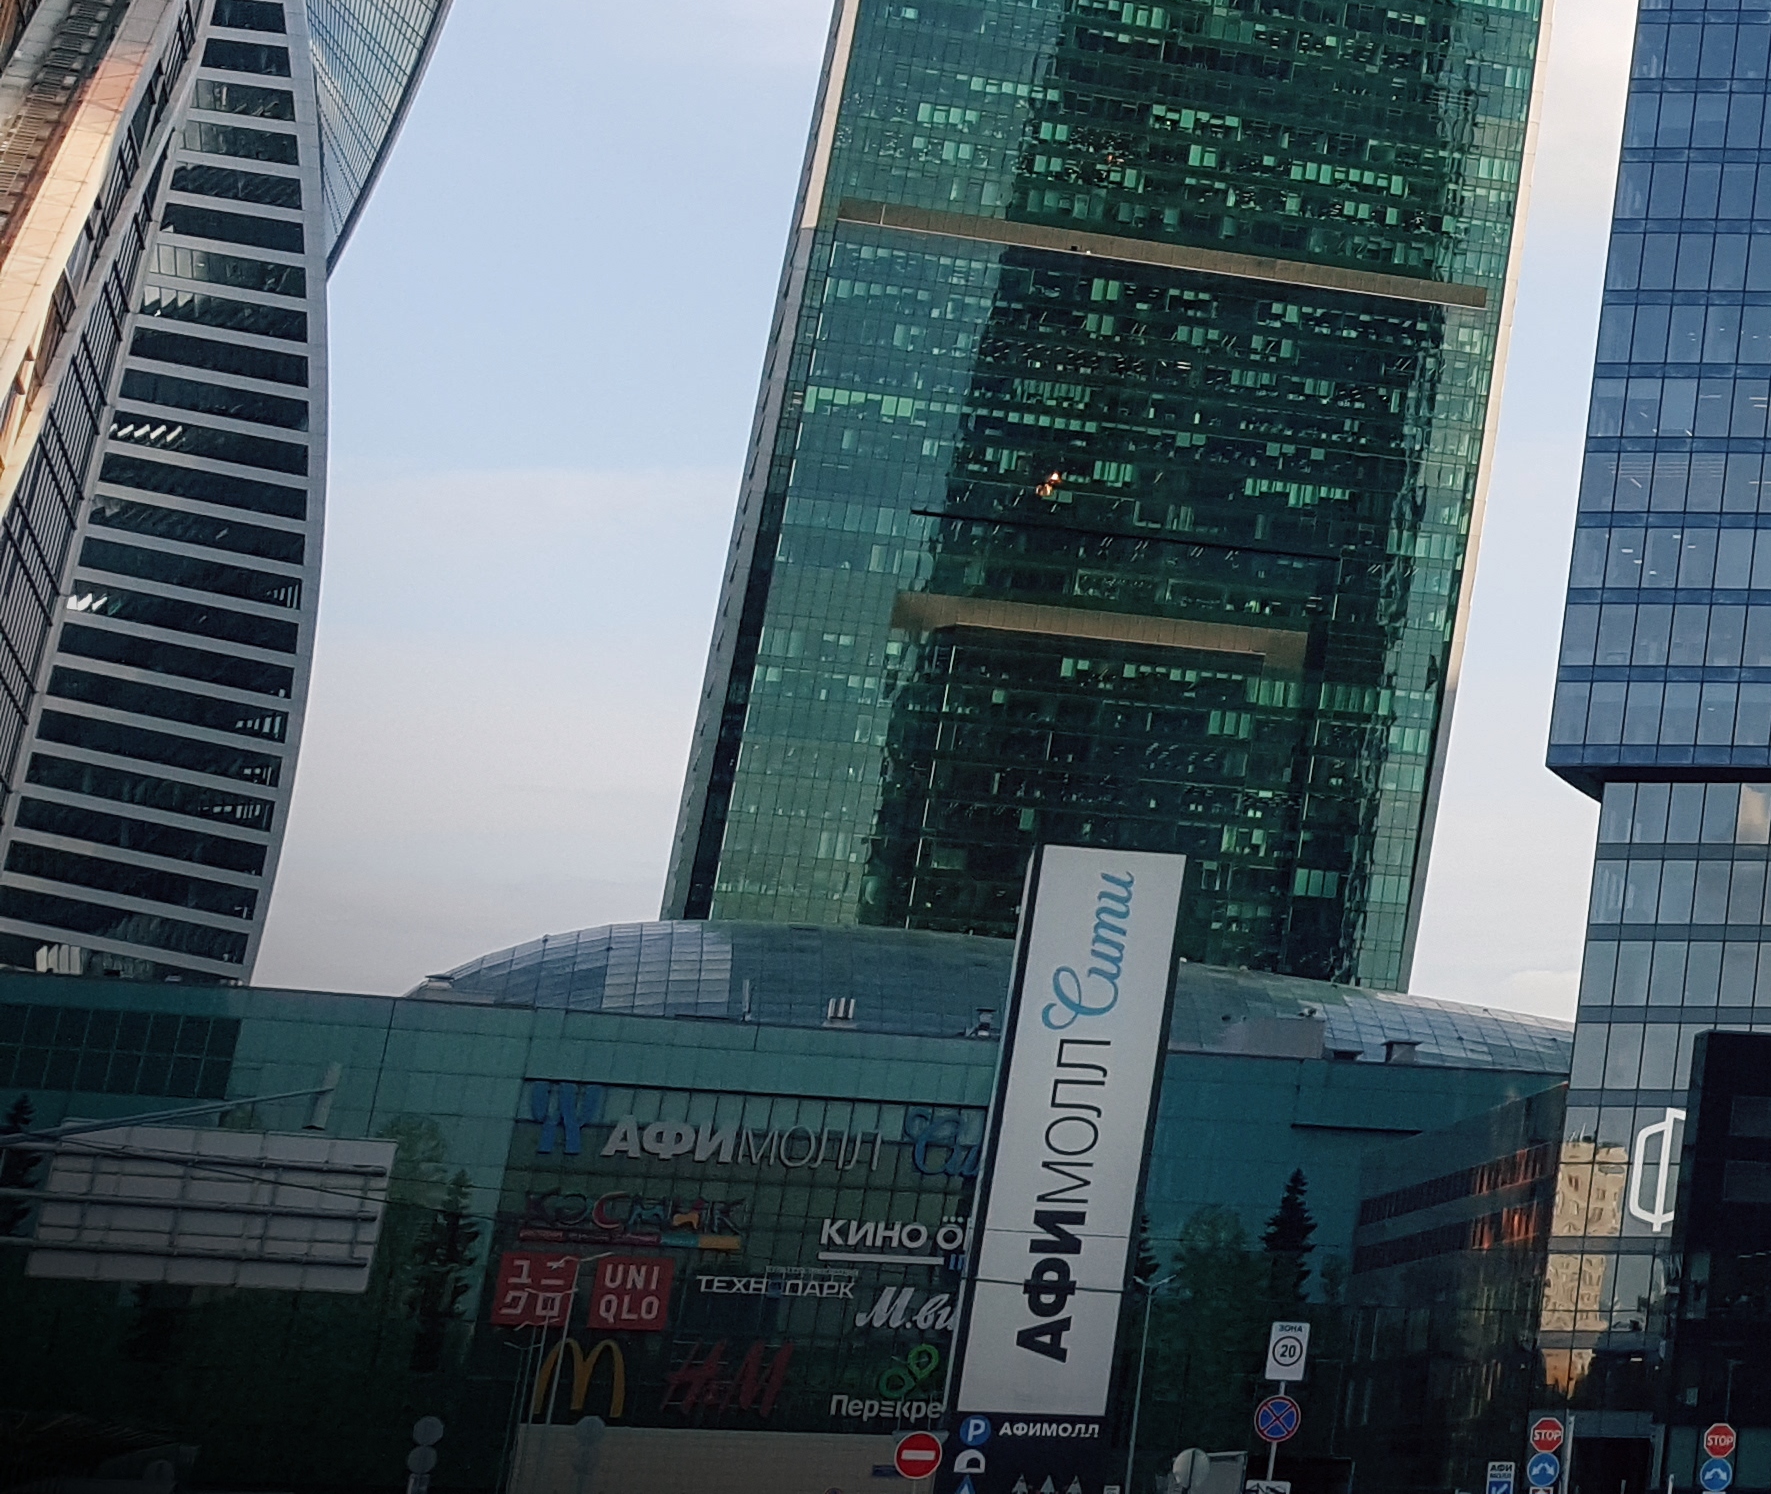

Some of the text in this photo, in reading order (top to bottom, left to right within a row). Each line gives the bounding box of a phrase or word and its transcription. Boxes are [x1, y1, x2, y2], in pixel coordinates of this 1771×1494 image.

[1015, 870, 1136, 1364] АФИМОЛЛ Сити
[601, 1107, 981, 1178] АФИМОЛЛ Си
[819, 1218, 928, 1249] КИНО
[603, 1263, 661, 1291] UNI
[598, 1293, 661, 1324] QLO
[1278, 1324, 1303, 1333] ЗОНА
[1279, 1344, 1296, 1358] 20
[829, 1394, 944, 1424] Перекре
[997, 1421, 1100, 1439] АФИМОЛЛ
[1533, 1429, 1563, 1441] STOP
[1707, 1435, 1734, 1447] STOP
